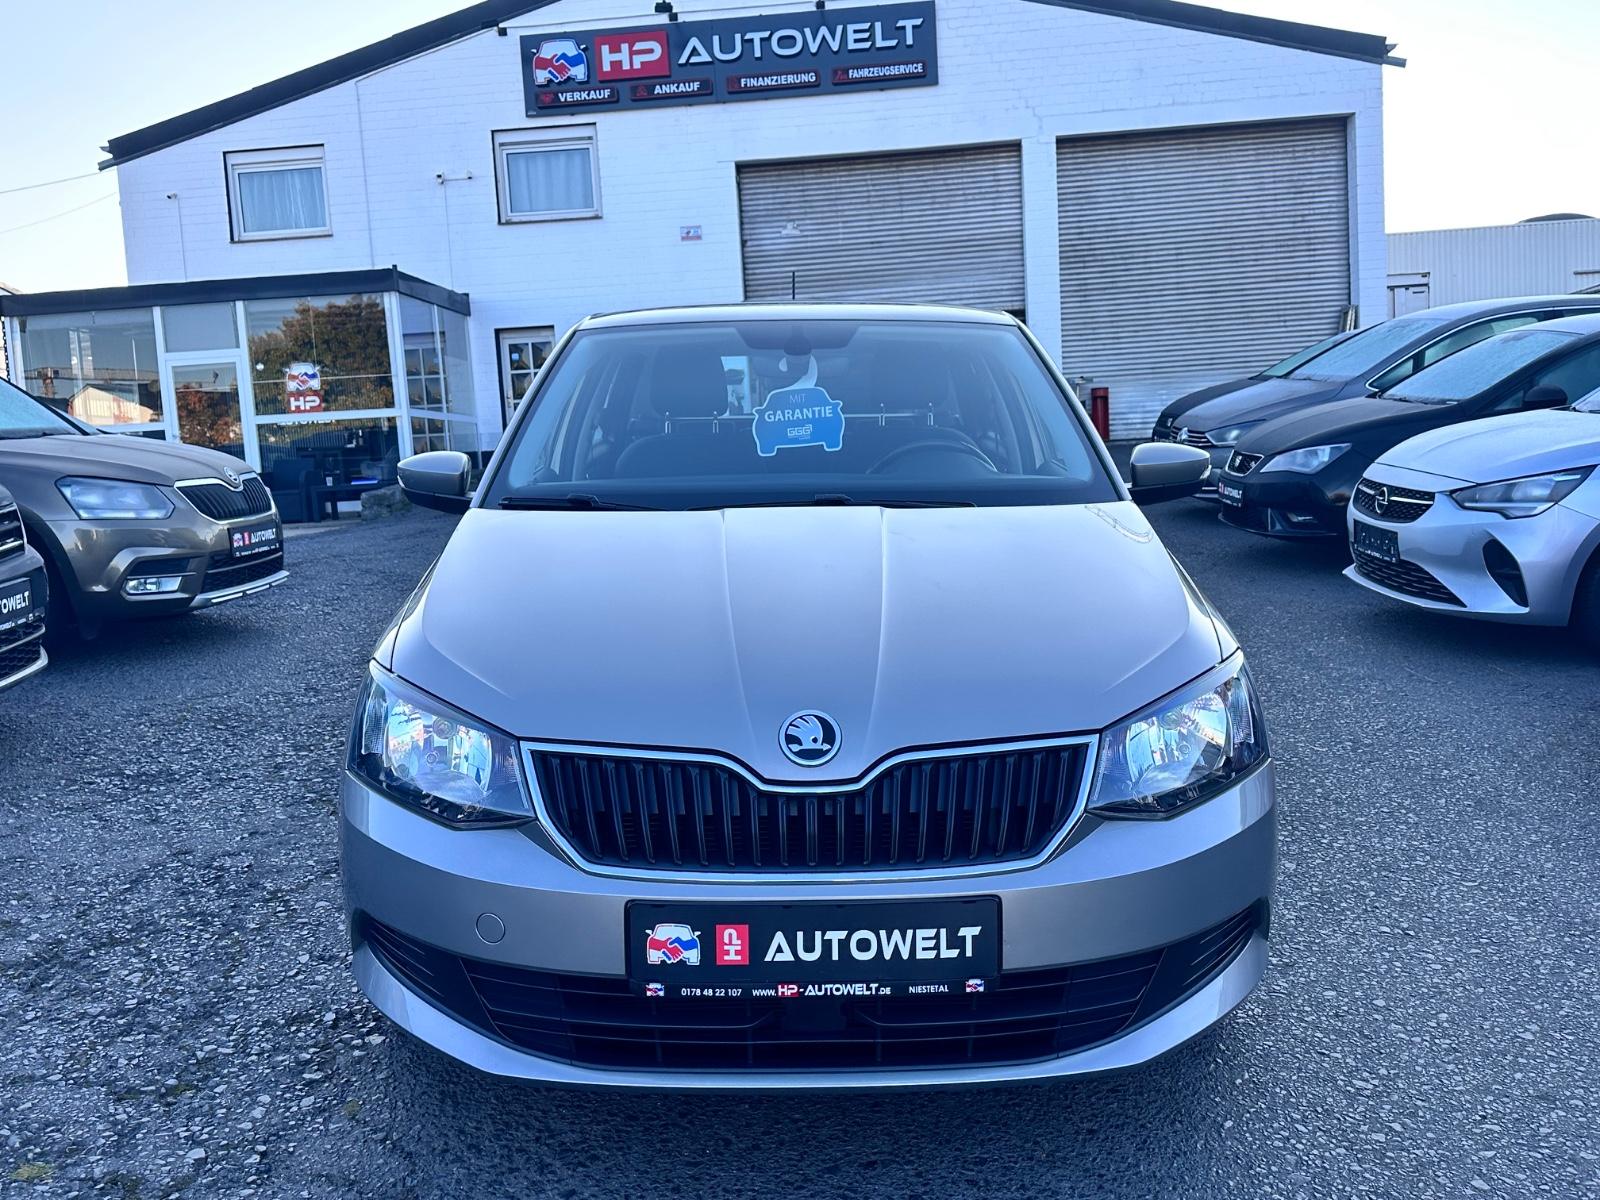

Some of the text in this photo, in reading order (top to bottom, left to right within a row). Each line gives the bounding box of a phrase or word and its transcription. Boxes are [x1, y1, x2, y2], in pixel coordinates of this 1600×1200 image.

[600, 18, 923, 72] HP AUTOWELT
[848, 63, 924, 79] FAHRZEUGSERVICE
[740, 72, 816, 88] FINANZIERUNG
[558, 89, 611, 102] VERKAUF
[654, 81, 700, 95] ANKAUF
[289, 395, 320, 411] HP
[789, 393, 807, 404] MIT
[764, 406, 833, 422] GARANTIE
[787, 424, 813, 436] GGG
[250, 528, 276, 543] AUTOWELT
[723, 928, 742, 960] HP
[764, 926, 982, 961] AUTOWELT
[681, 988, 742, 997] 0178 48 22 107
[908, 984, 949, 994] NIESTETAL
